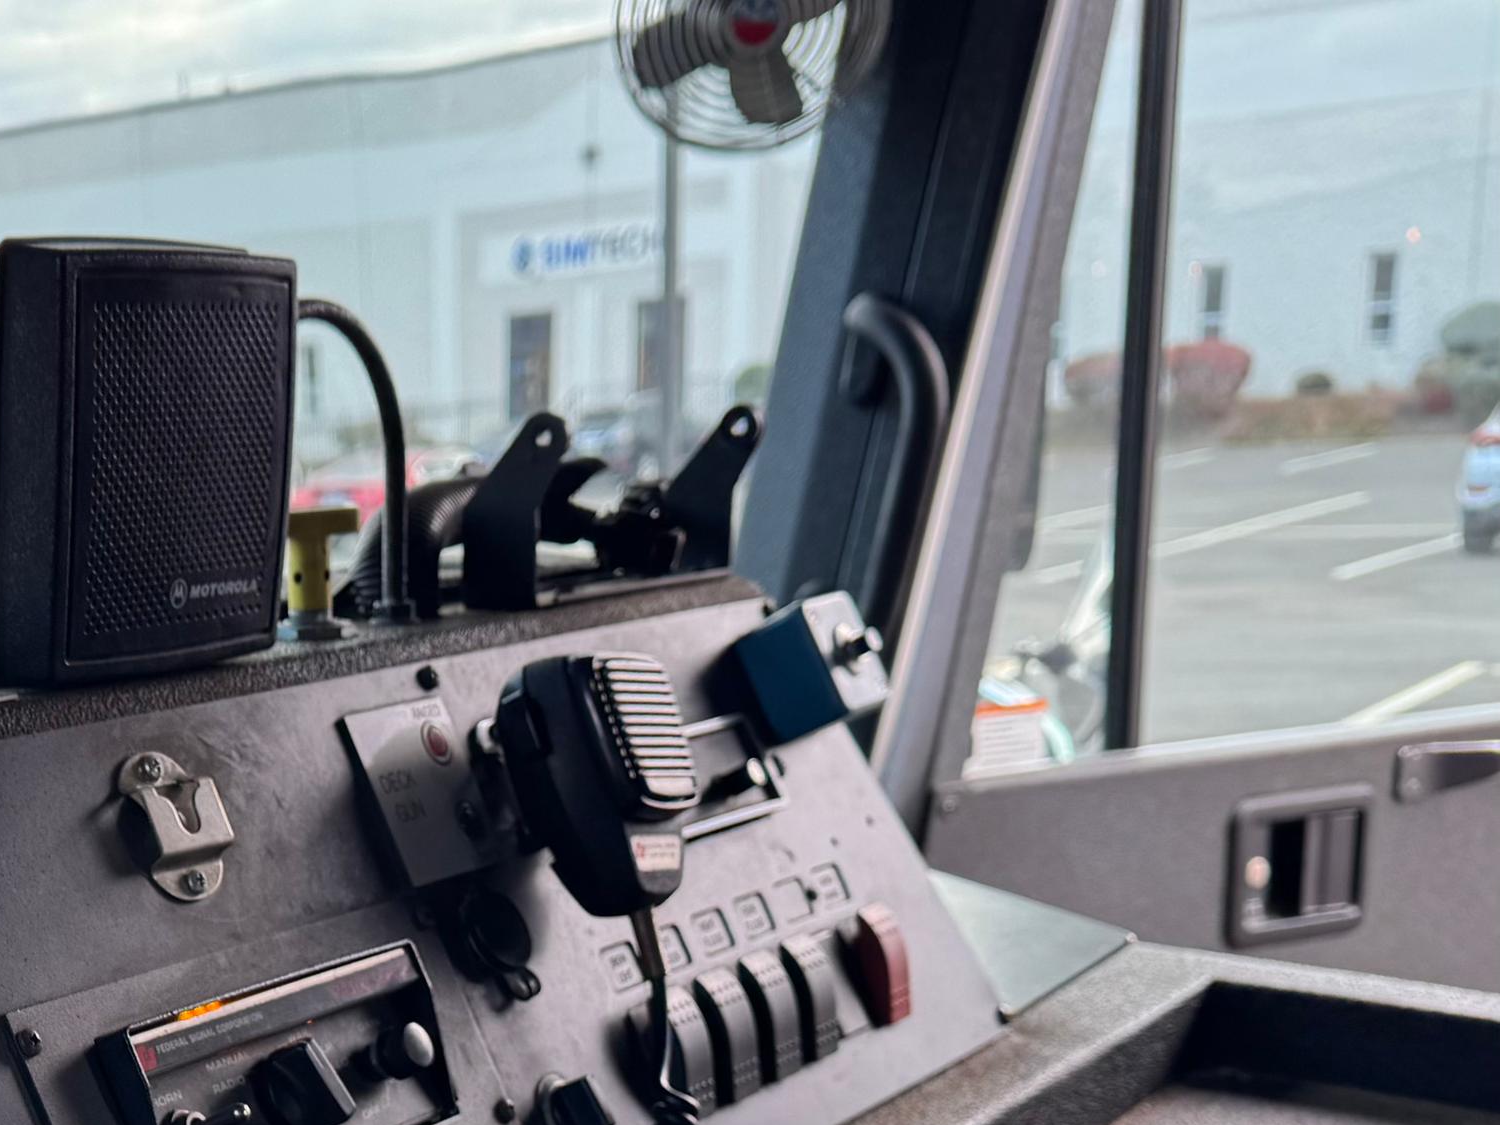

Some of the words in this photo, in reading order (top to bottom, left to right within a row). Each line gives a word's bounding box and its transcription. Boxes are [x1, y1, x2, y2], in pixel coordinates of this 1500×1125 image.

[189, 579, 258, 599] MOTOROLA
[156, 1037, 188, 1054] FEDERAL
[212, 1075, 246, 1095] RADIO
